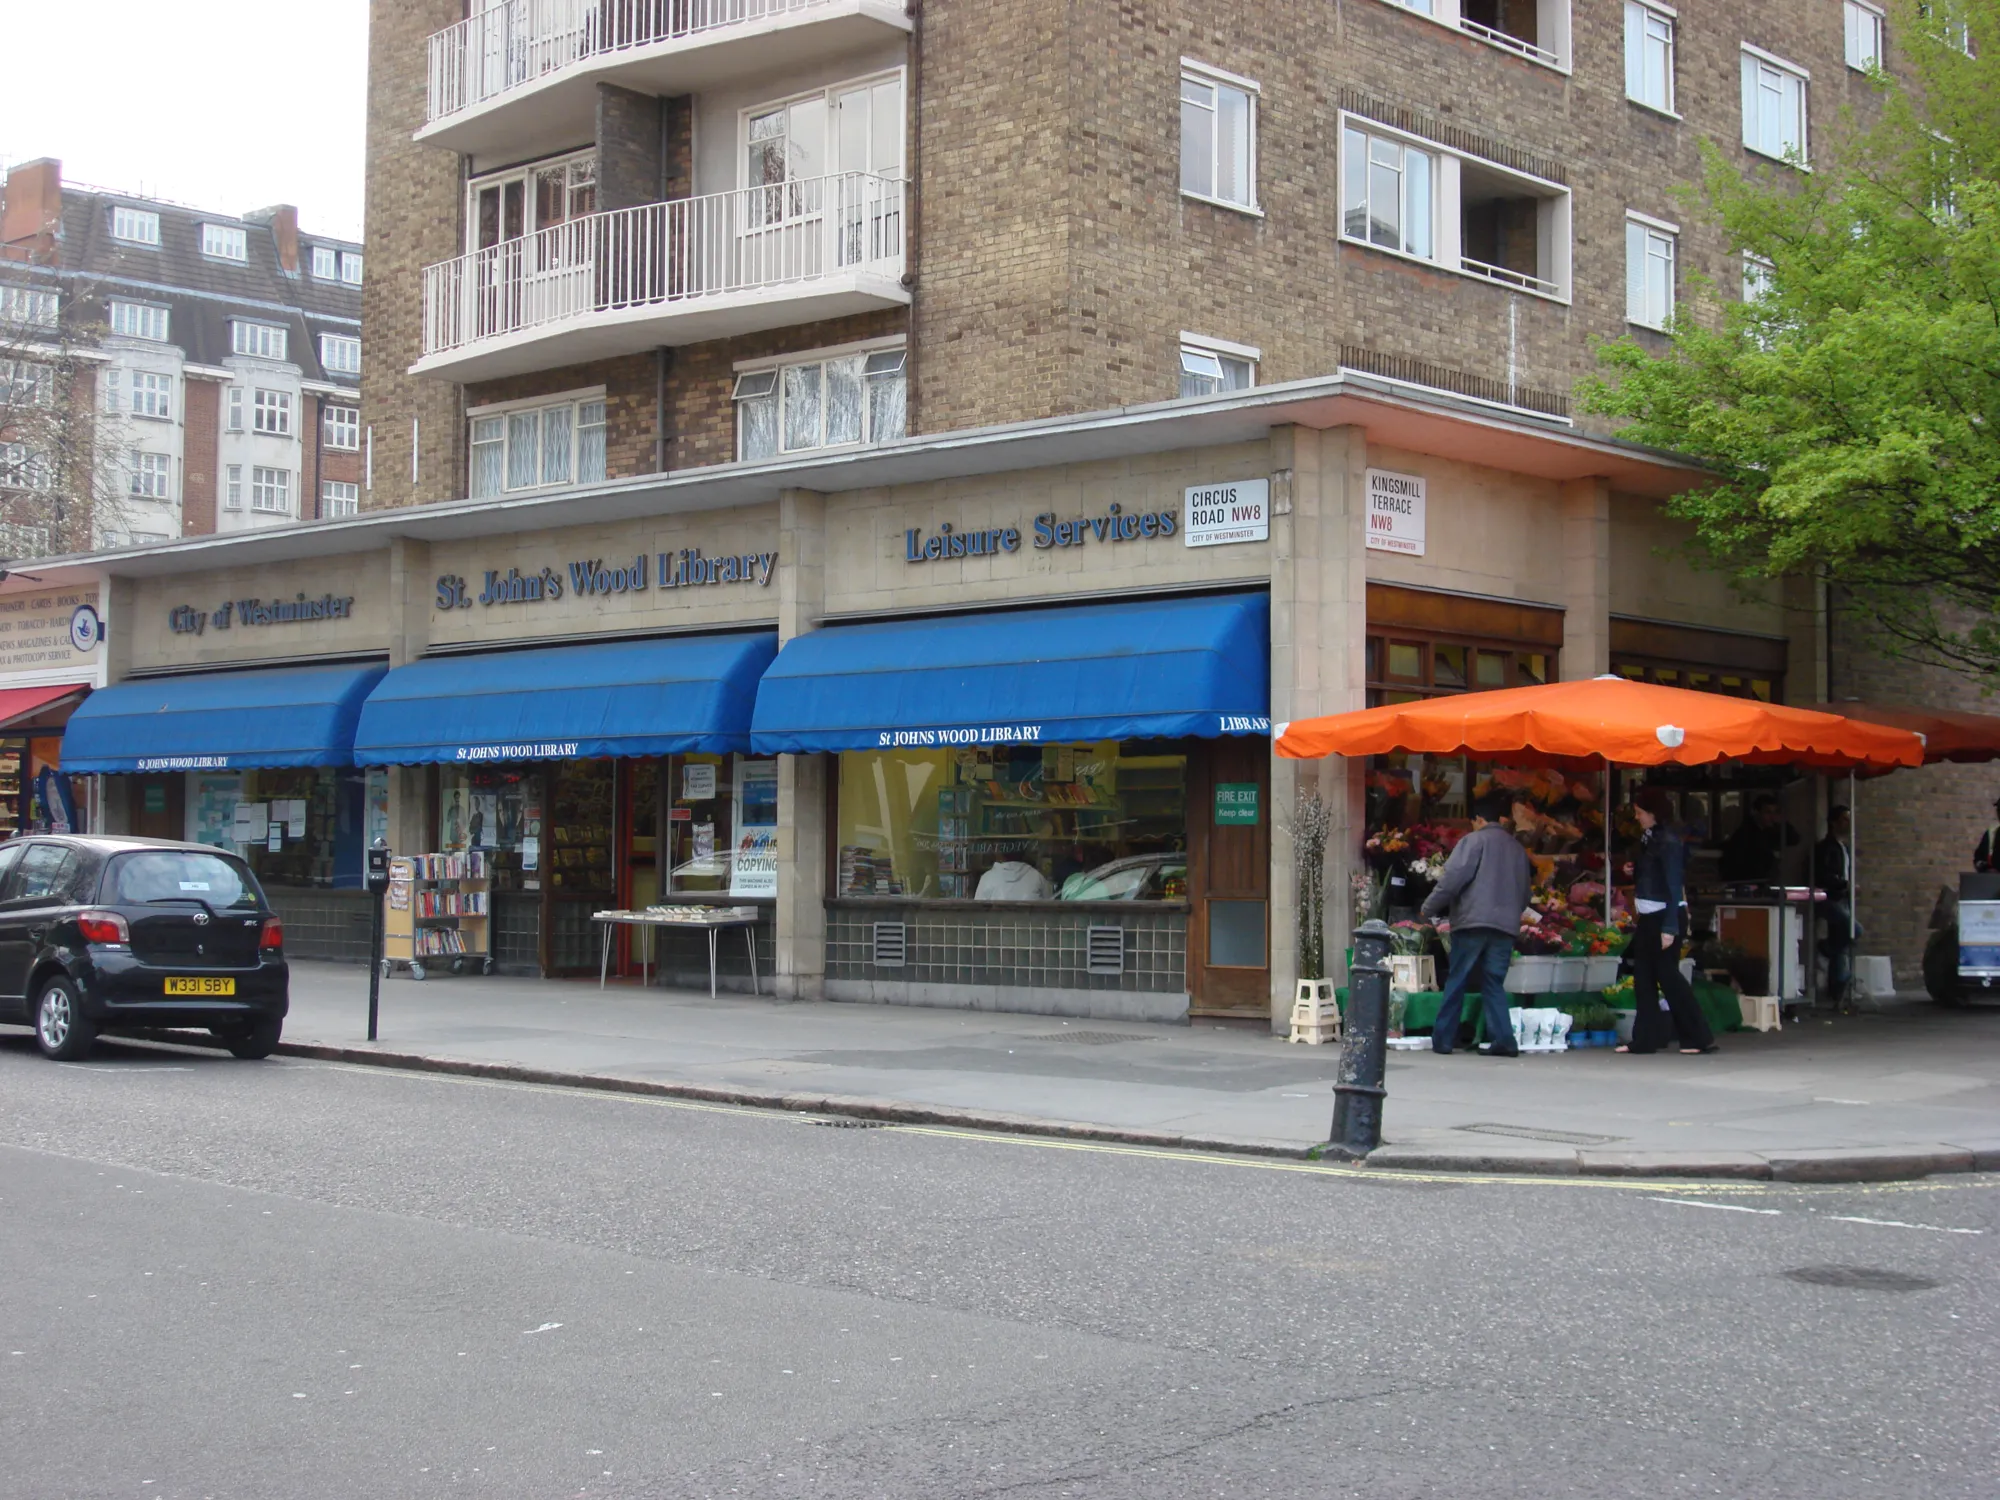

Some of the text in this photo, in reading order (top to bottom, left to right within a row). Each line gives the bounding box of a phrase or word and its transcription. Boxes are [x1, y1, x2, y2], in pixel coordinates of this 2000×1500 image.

[1372, 475, 1420, 498] KINGSMILL
[1192, 488, 1237, 507] CIRCUS
[1372, 494, 1412, 515] TERRACE
[1192, 505, 1261, 526] ROAD NW8
[1371, 514, 1392, 531] NW8
[906, 503, 1178, 562] Leisure Services
[1214, 530, 1254, 540] WESTMINSTER
[1370, 537, 1380, 545] CITY
[1387, 540, 1416, 551] WESTMINSTER
[436, 548, 778, 609] St. John's Wood Library
[57, 595, 79, 607] BOOKS
[168, 592, 355, 635] City of Westminster
[18, 636, 51, 648] MAGAZINES
[13, 652, 47, 663] PHOTOCOPY
[48, 650, 71, 660] SERVICE
[879, 726, 1041, 746] St JOHNS WOOD LIBRARY
[456, 743, 578, 759] St JOHNS WOOD LIBRARY
[137, 756, 228, 770] St JOHNS WOOD LIBRARY
[1217, 791, 1256, 801] FIRE EXIT
[1218, 808, 1255, 818] Keep clear
[737, 858, 777, 872] COPYING
[171, 978, 231, 992] W331 SBY
